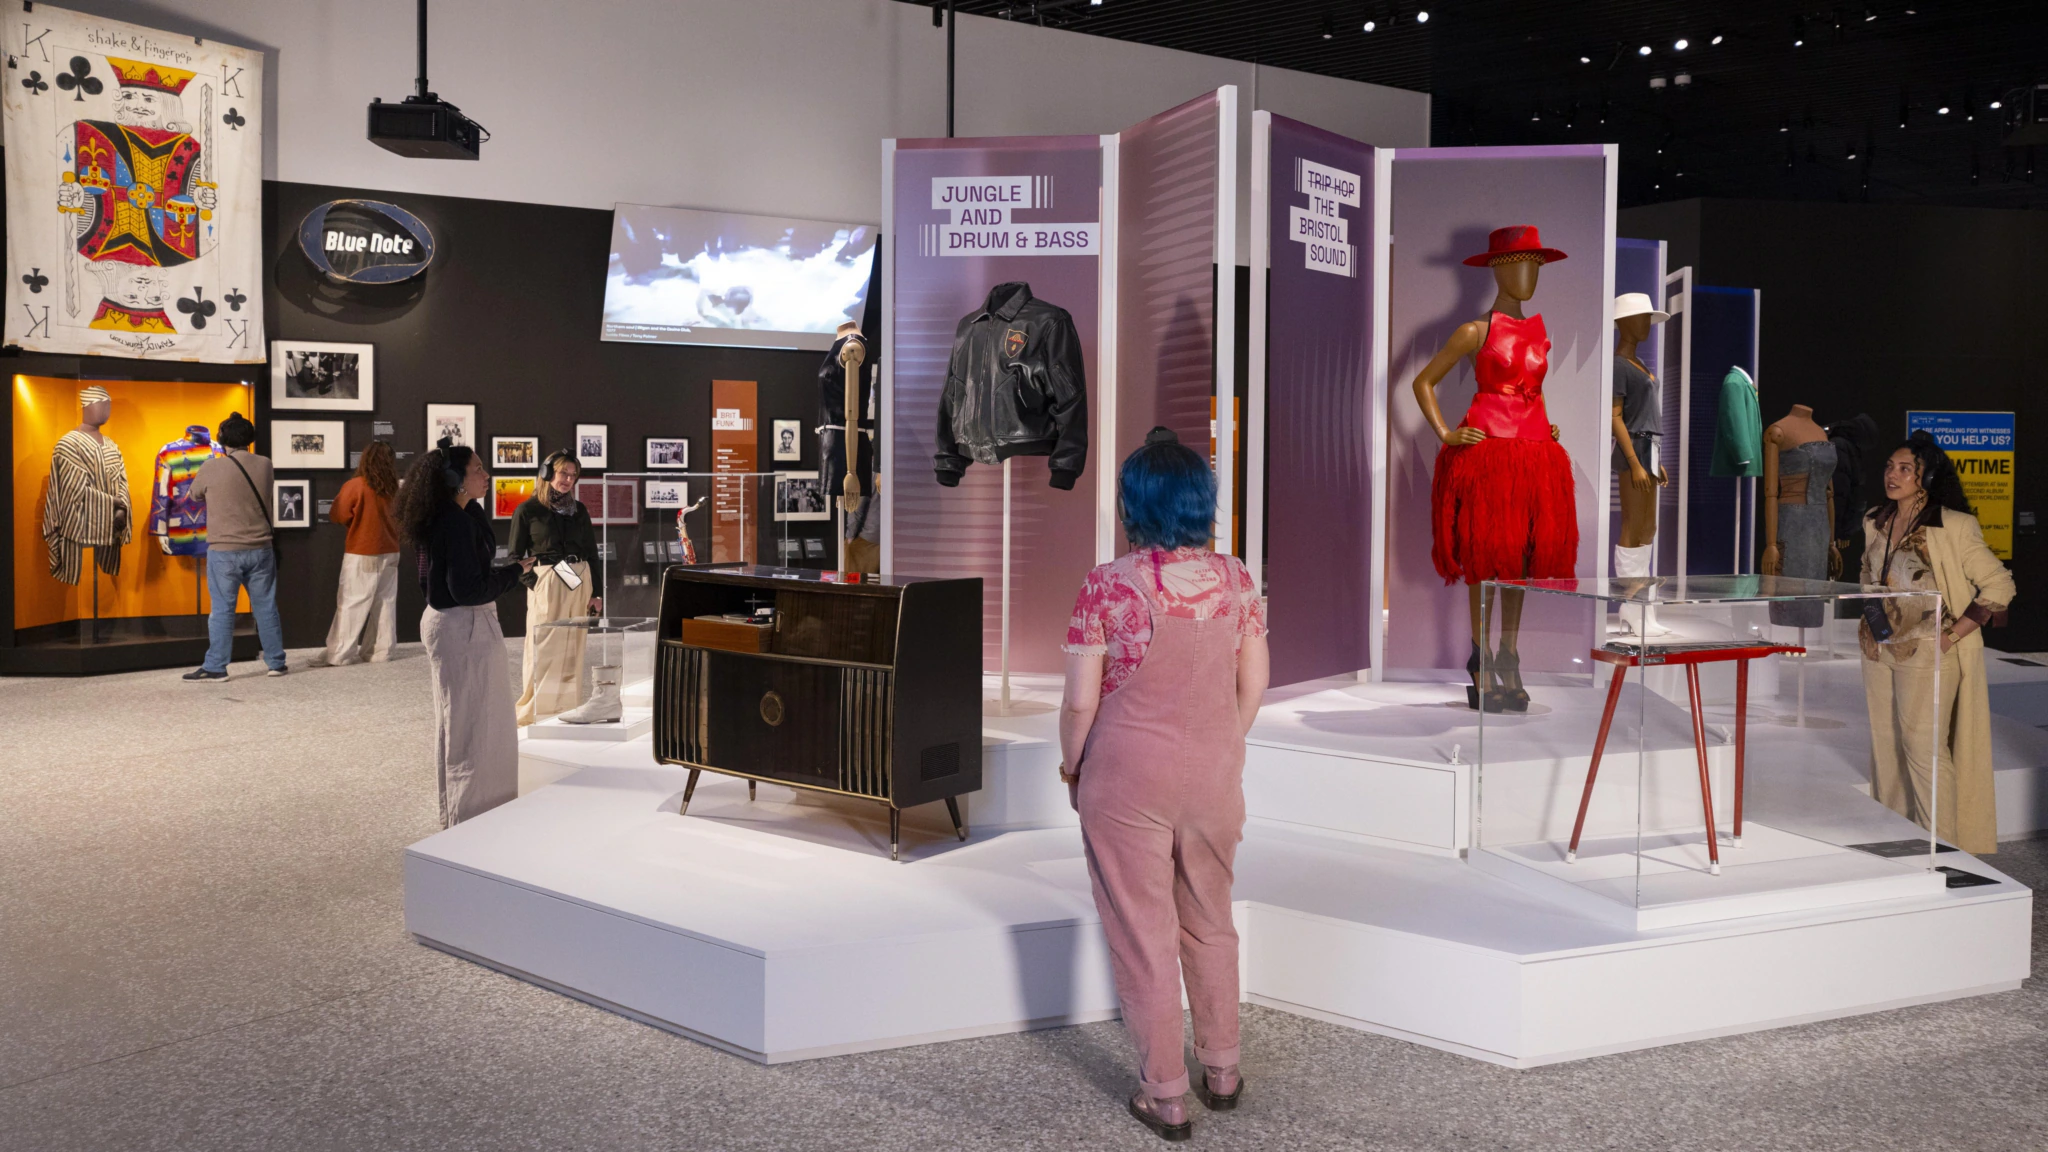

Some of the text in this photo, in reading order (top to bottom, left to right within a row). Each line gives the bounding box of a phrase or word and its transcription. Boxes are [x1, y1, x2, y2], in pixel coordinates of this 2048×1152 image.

[21, 23, 52, 62] K
[88, 29, 192, 63] shake & fingerpop
[221, 64, 244, 98] K
[942, 185, 1021, 202] JUNGLE
[960, 209, 1002, 225] AND
[1314, 196, 1334, 217] THE
[949, 231, 1089, 248] DRUM & BASS
[1299, 216, 1343, 243] BRISTOL
[370, 232, 414, 254] Note
[1310, 244, 1347, 267] SOUND
[23, 304, 51, 339] K
[224, 318, 249, 349] K
[716, 419, 735, 427] FUNK
[1936, 435, 2011, 445] YOU HELP US?
[1951, 458, 2010, 474] WTIME
